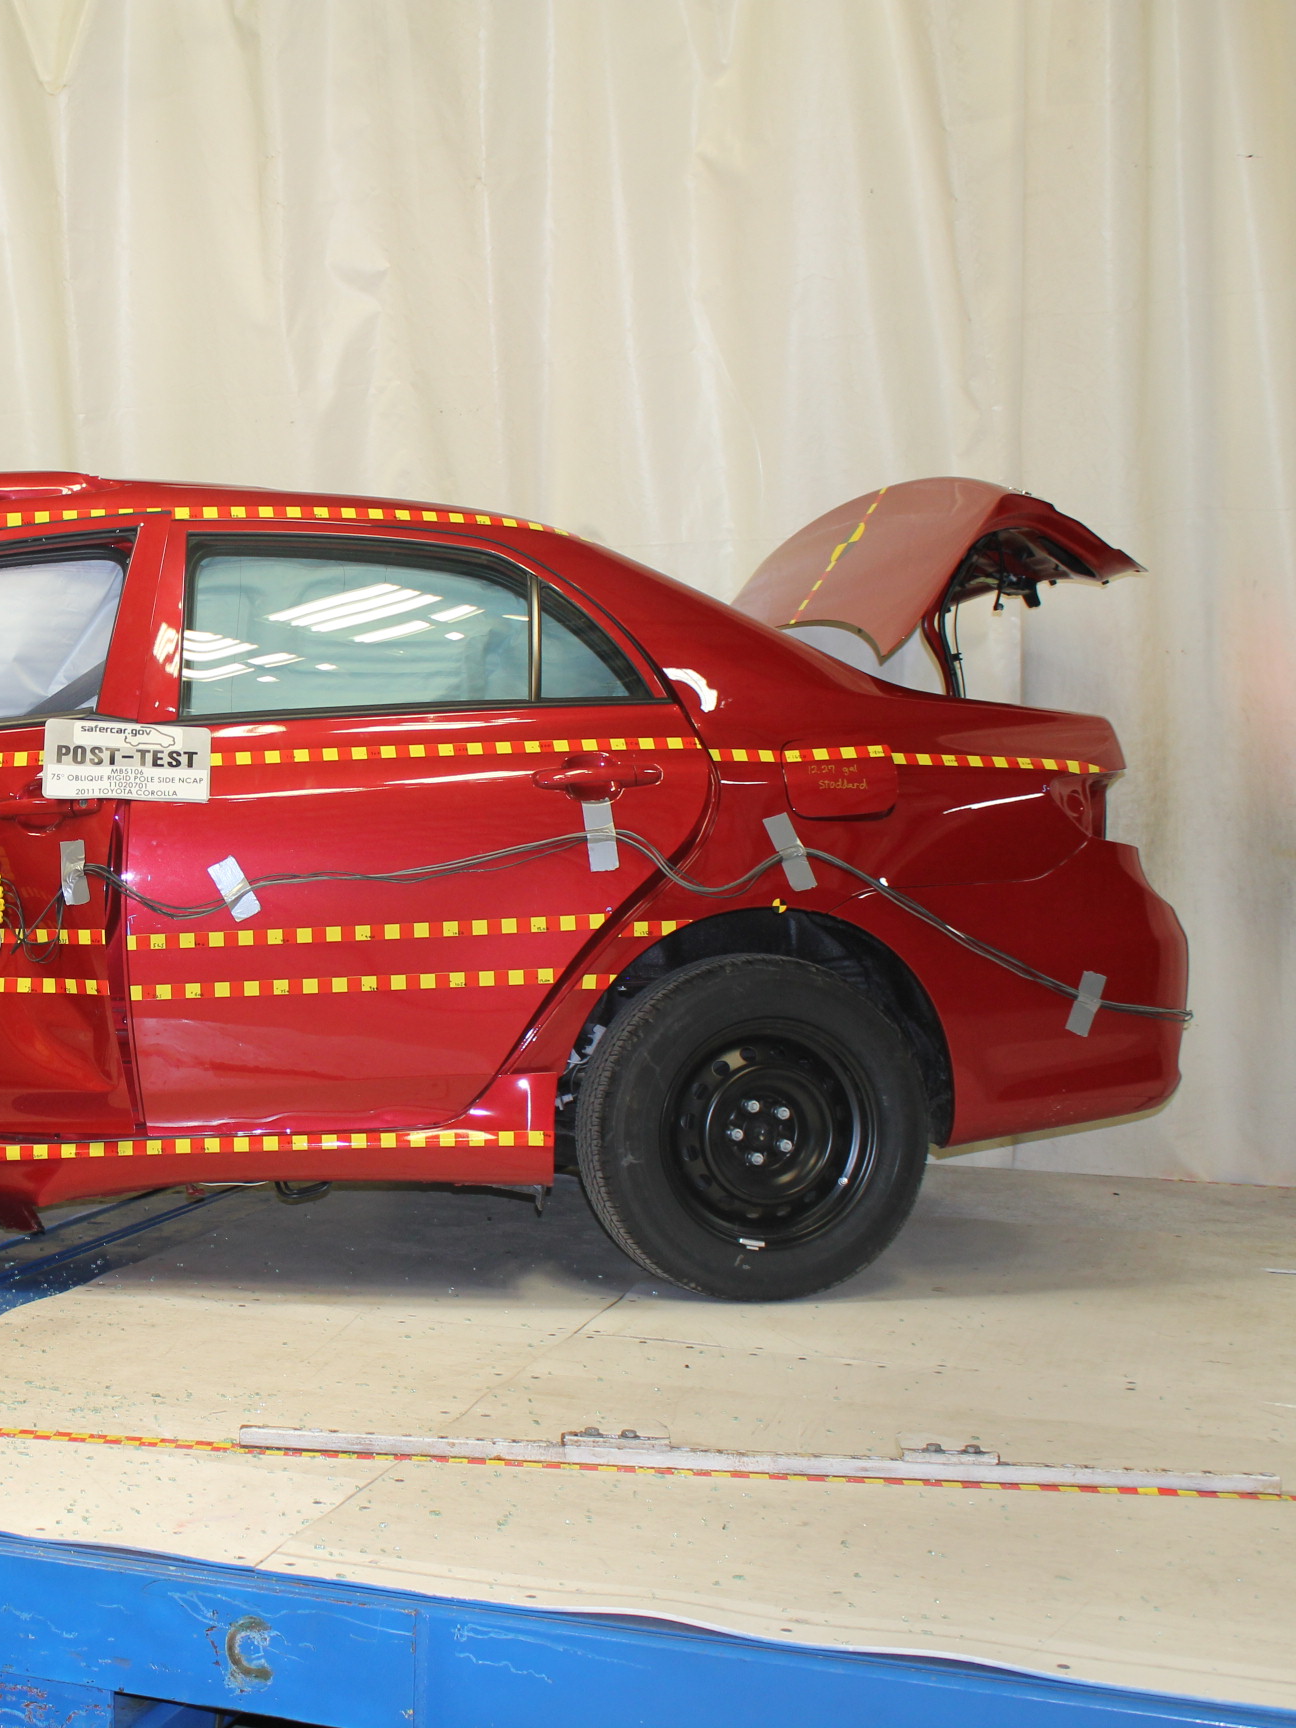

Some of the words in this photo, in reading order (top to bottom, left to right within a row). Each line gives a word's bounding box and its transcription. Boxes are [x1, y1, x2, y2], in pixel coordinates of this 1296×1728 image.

[80, 724, 152, 737] safercar.gov
[56, 744, 198, 768] POST-TEST
[110, 768, 144, 776] MB5106
[67, 774, 104, 782] OBLIQUE
[134, 775, 155, 783] POLE
[157, 776, 176, 784] SIDE
[108, 781, 148, 789] 11020701
[75, 788, 95, 796] 2011
[98, 788, 133, 796] TOYOTA
[136, 789, 178, 797] COROLLA
